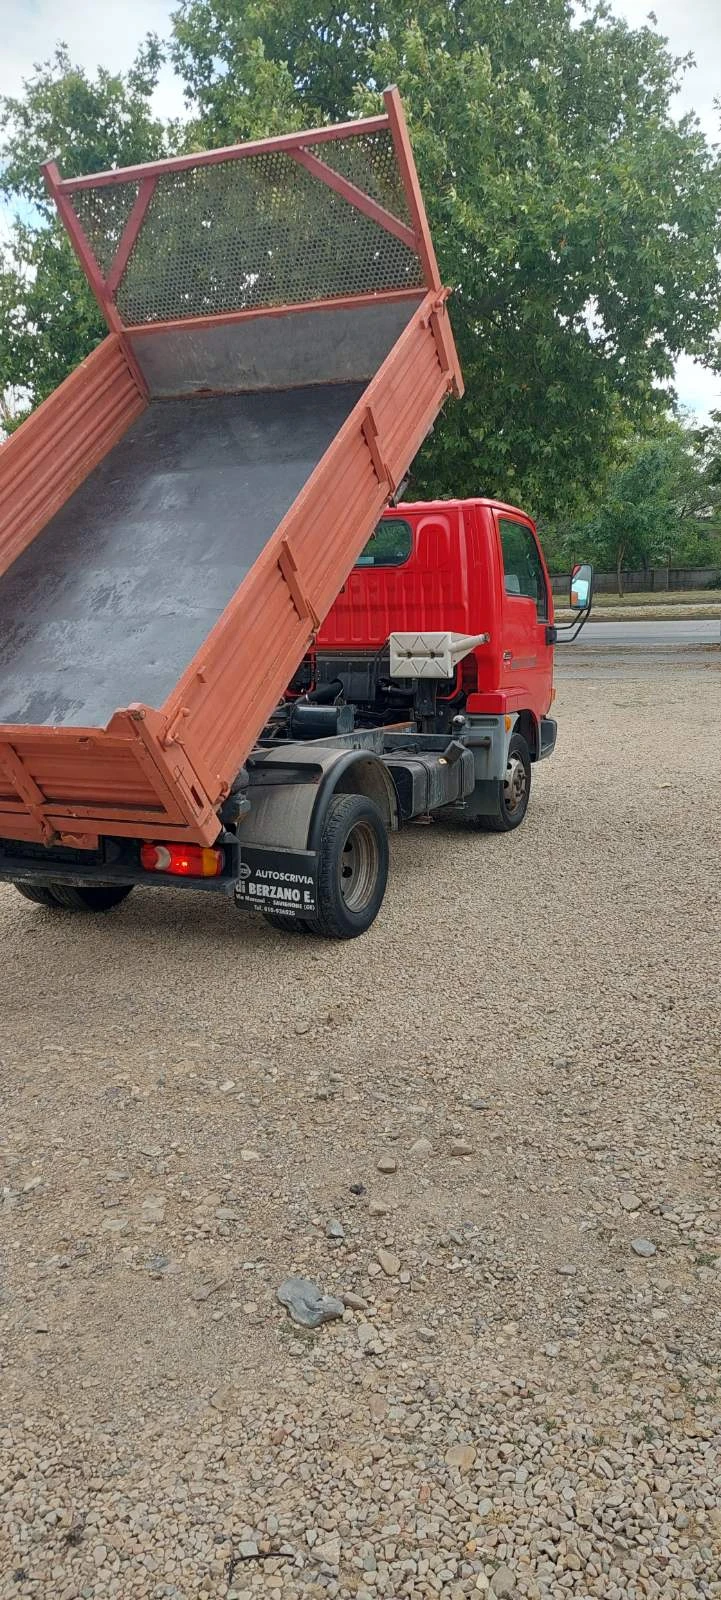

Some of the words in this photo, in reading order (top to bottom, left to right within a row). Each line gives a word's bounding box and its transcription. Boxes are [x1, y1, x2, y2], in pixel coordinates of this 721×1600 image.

[255, 869, 314, 884] AUTOSCRIVIA
[235, 880, 246, 893] di
[248, 882, 300, 901] BERZANO
[304, 891, 314, 903] E.
